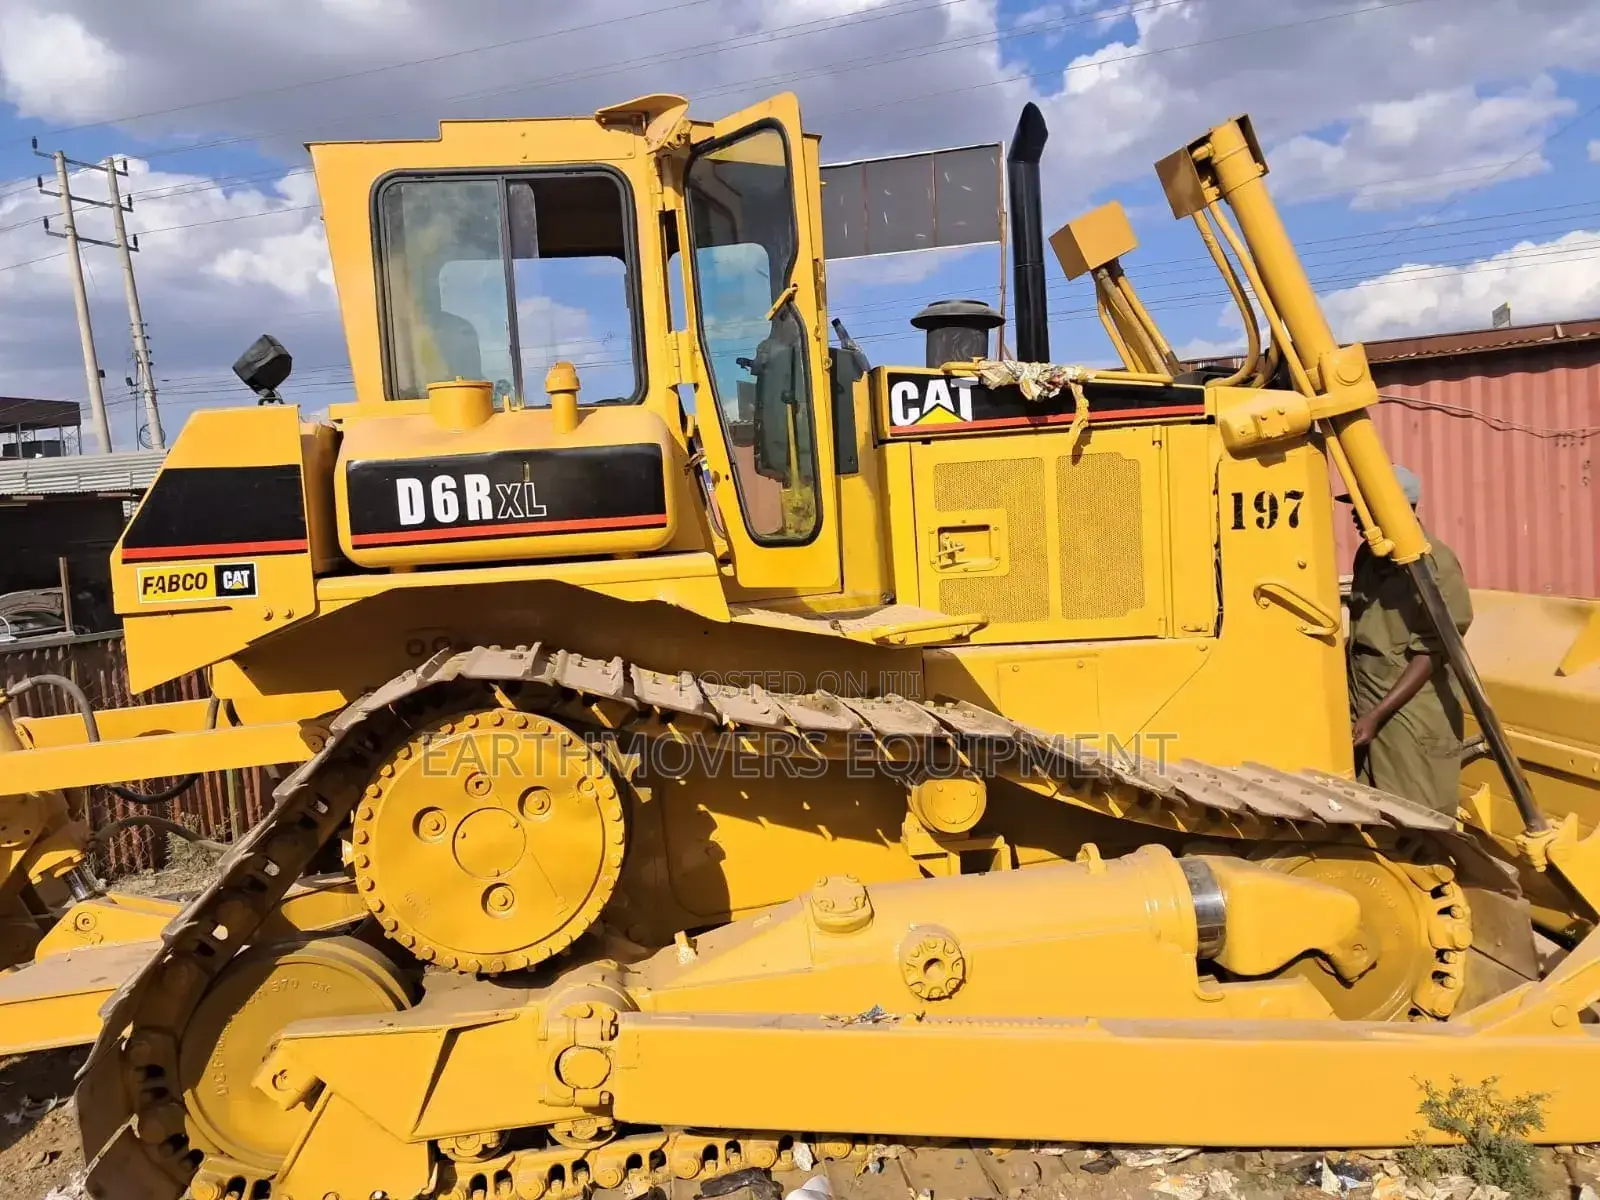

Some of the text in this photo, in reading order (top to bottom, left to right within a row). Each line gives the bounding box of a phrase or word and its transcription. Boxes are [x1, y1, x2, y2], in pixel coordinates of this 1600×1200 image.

[890, 376, 979, 427] CAT
[1231, 490, 1304, 530] 197
[142, 572, 208, 595] FABCO
[222, 570, 250, 589] CAT
